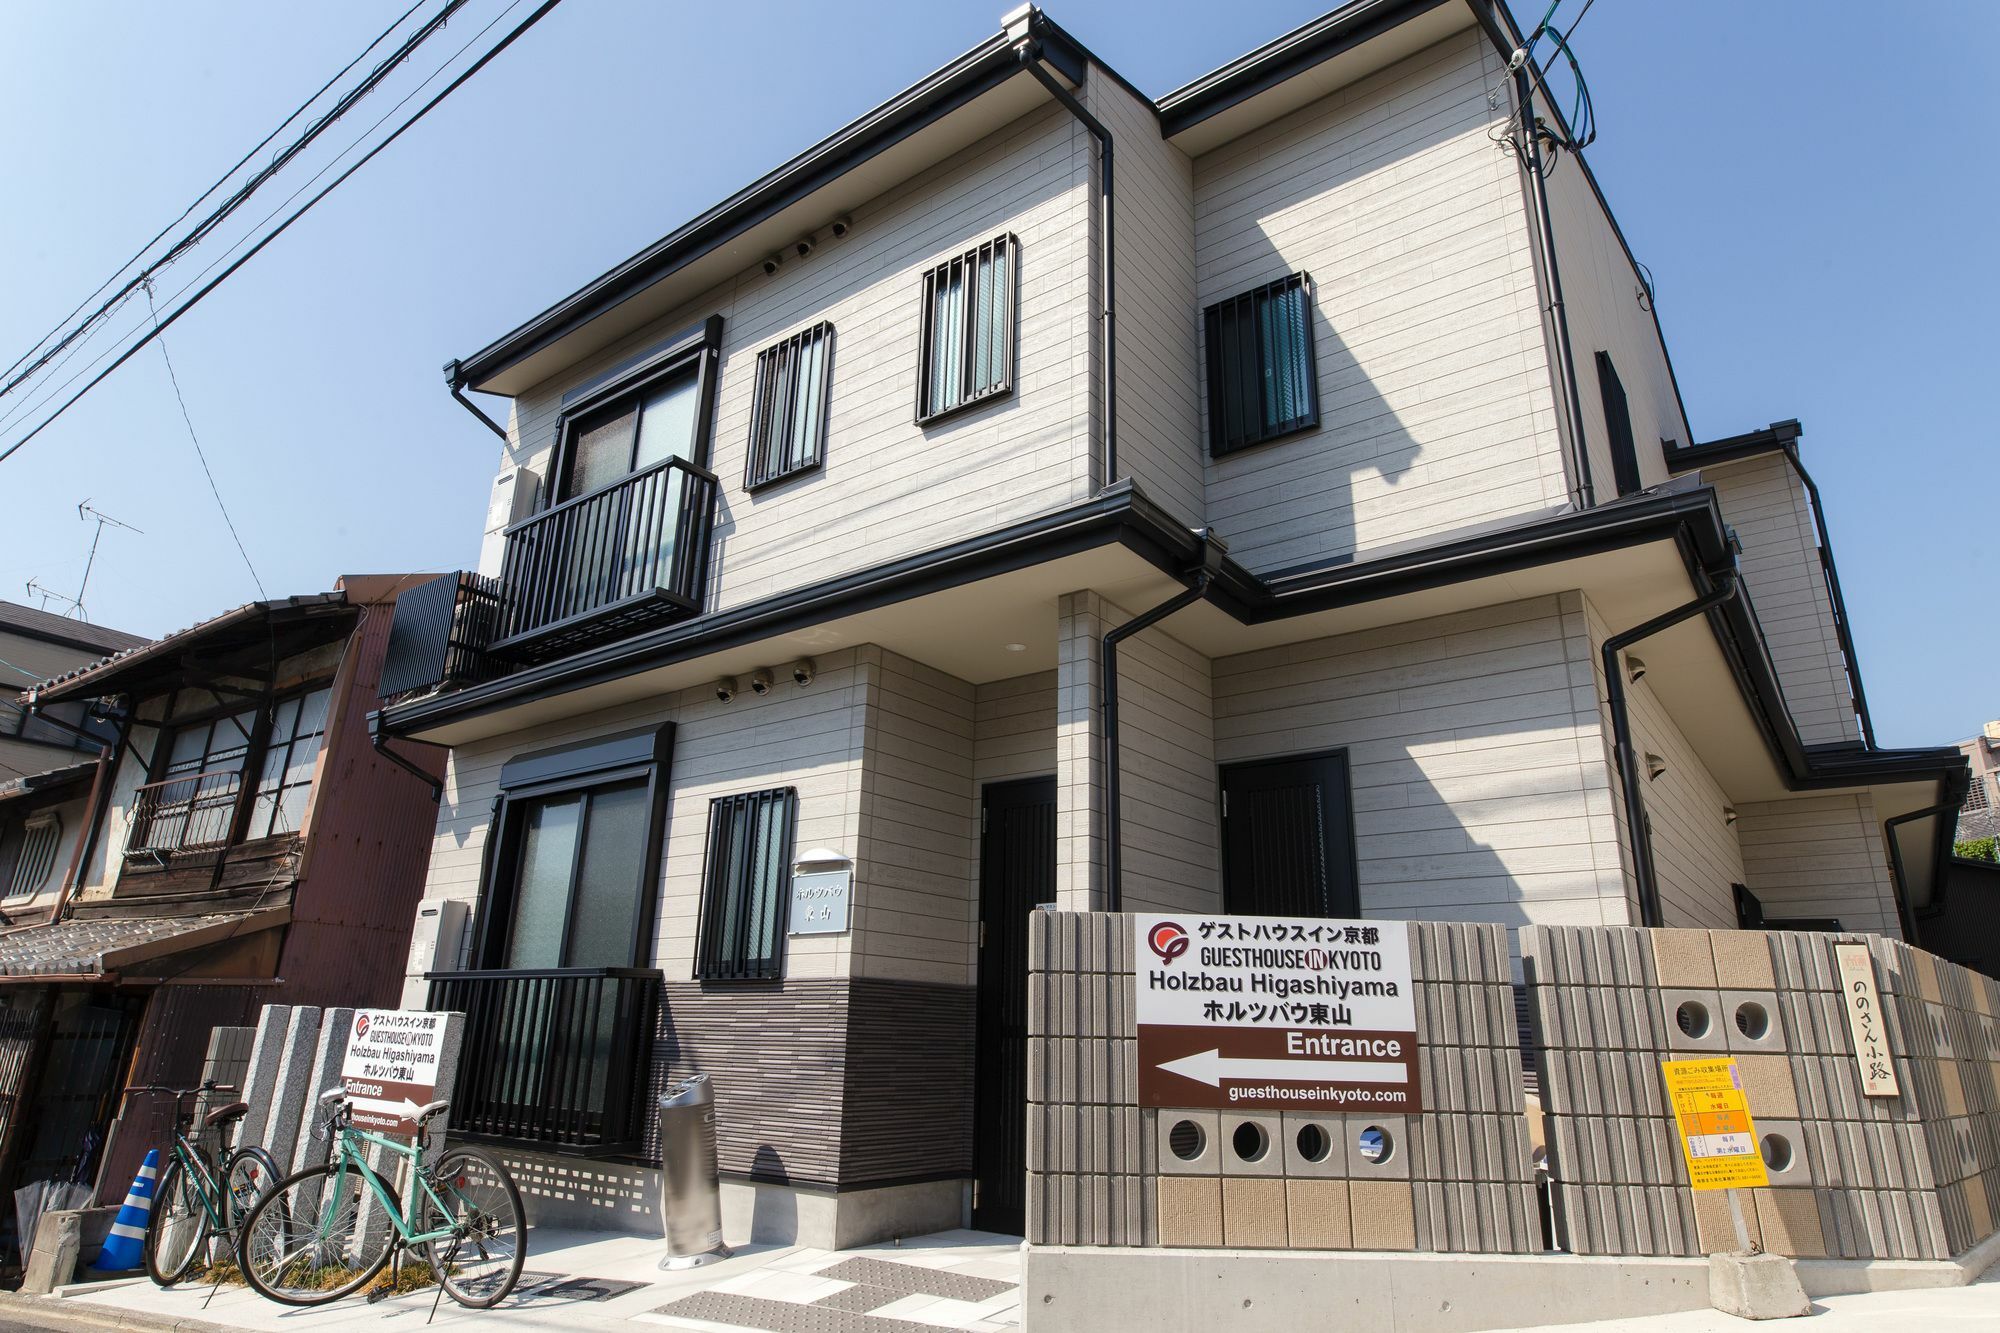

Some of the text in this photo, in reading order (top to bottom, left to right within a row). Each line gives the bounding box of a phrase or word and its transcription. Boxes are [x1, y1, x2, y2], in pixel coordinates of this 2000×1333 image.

[1198, 922, 1379, 945] ゲストハウスイン京都
[1149, 970, 1399, 1000] Holzbau Higashiyama
[373, 1014, 437, 1030] ゲストハウスイン京都
[1203, 1000, 1352, 1025] ホルツバウ東山
[350, 1044, 436, 1066] Holzbau Higashiyama
[1287, 1031, 1401, 1057] Entrance
[363, 1063, 415, 1082] ホルツバウ東山
[346, 1079, 383, 1097] Entrance
[1229, 1085, 1406, 1104] guesthouseinkyoto.com
